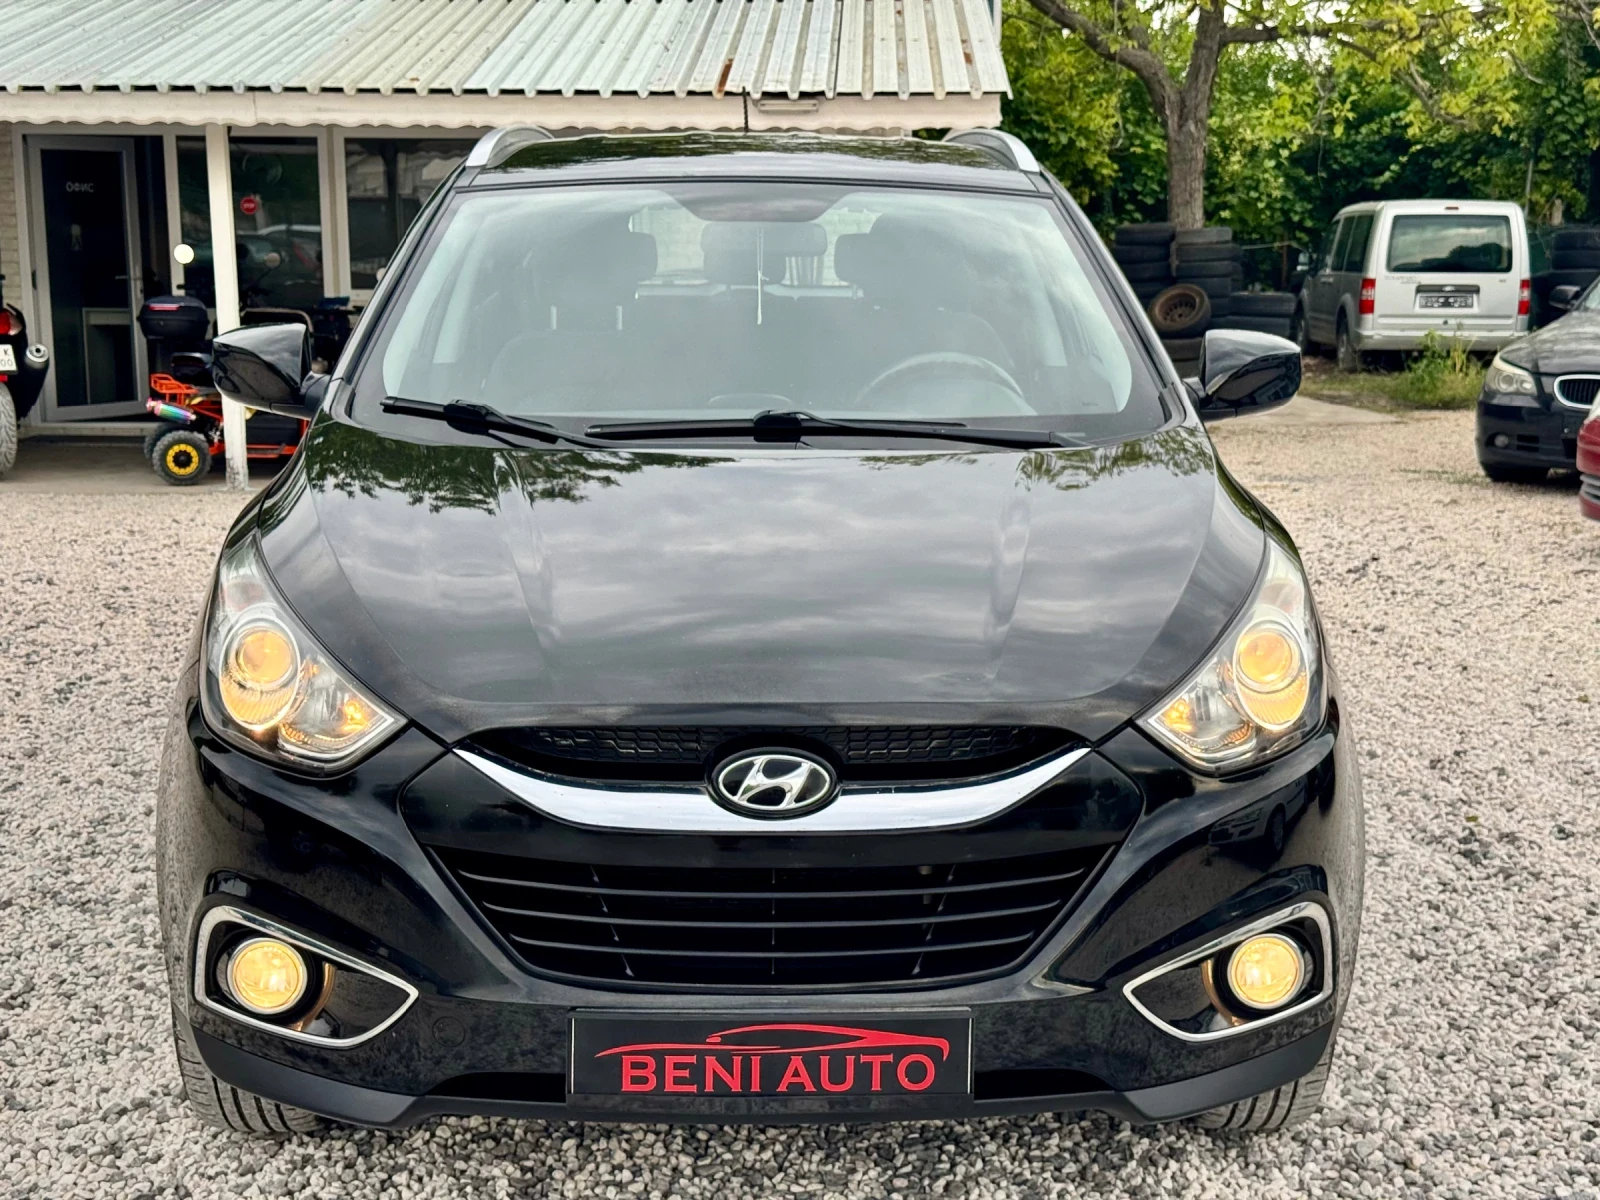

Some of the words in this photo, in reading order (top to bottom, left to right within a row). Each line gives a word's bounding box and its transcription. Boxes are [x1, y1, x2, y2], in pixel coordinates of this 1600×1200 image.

[65, 181, 94, 193] ОФИС
[621, 1055, 761, 1093] BENI
[777, 1053, 935, 1092] AUTO
